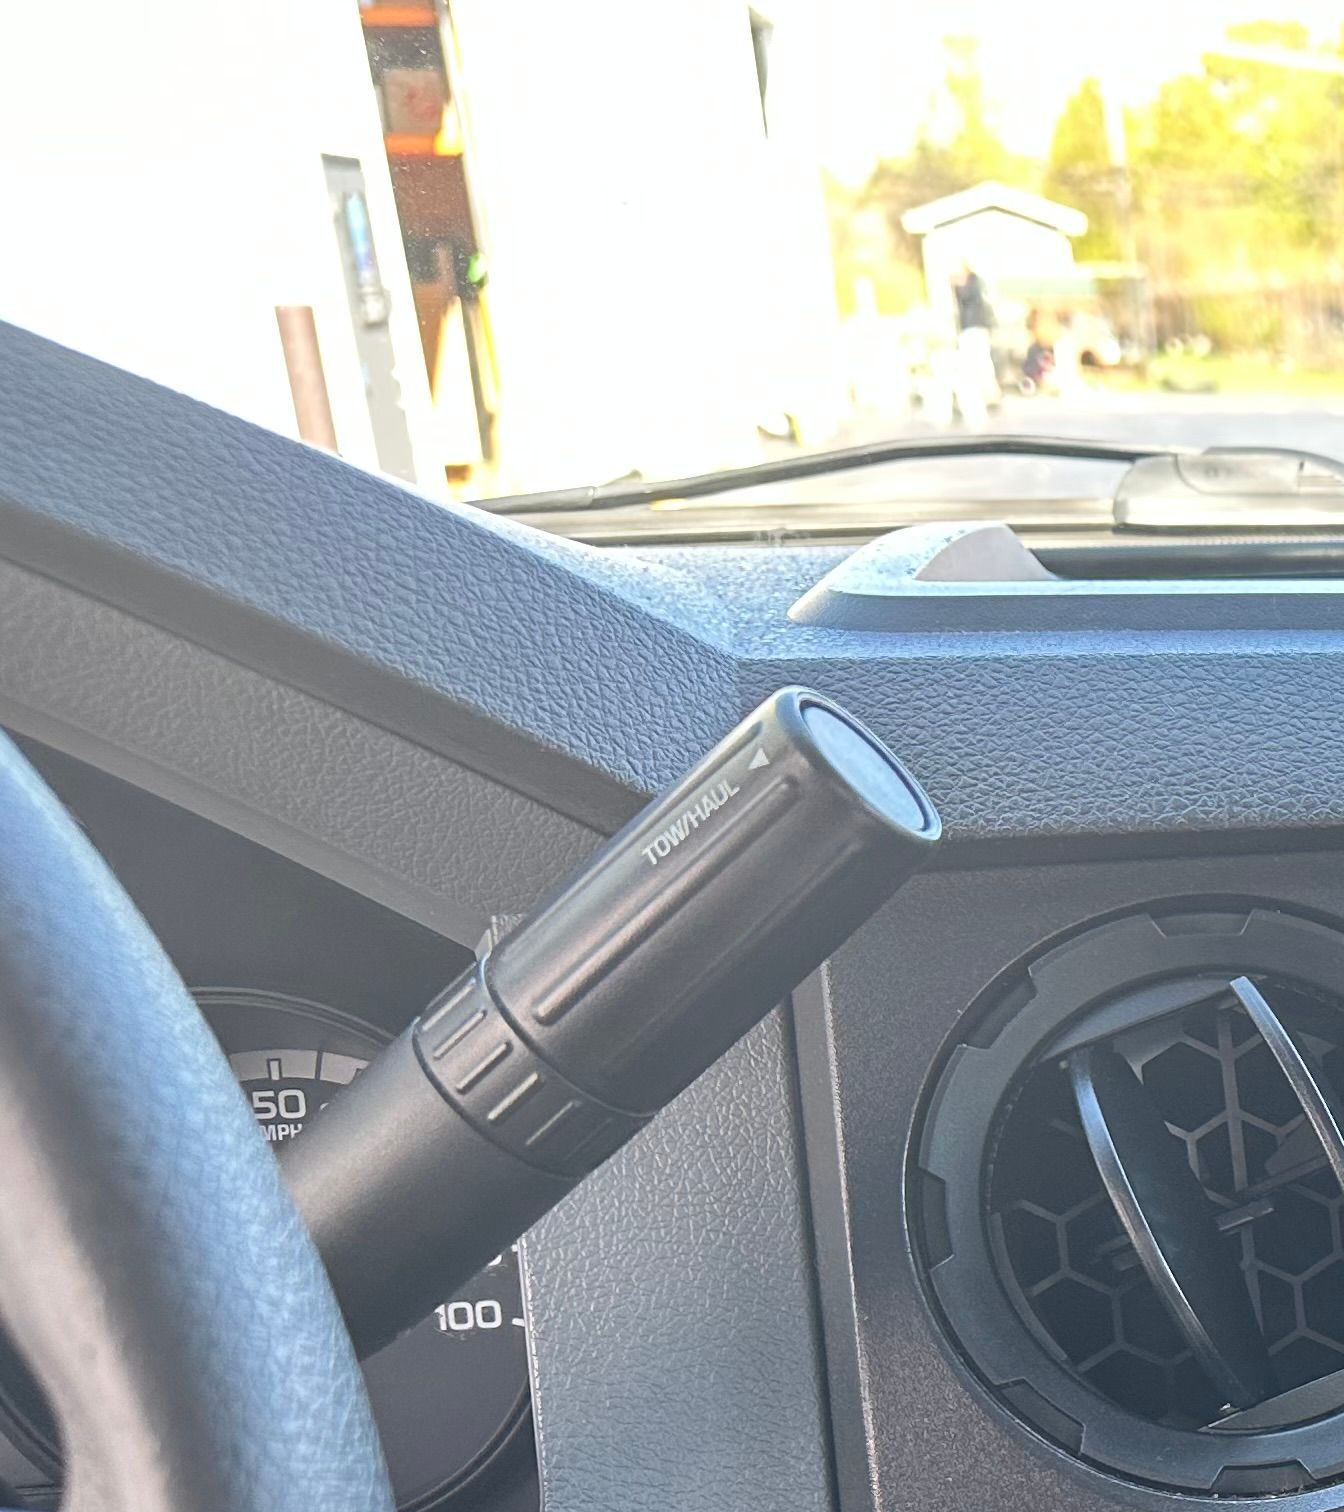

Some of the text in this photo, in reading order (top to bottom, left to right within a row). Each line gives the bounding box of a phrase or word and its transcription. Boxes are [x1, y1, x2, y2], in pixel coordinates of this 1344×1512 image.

[641, 779, 740, 865] TOW/HAUL
[252, 1089, 307, 1120] 50
[433, 1299, 503, 1331] 100
